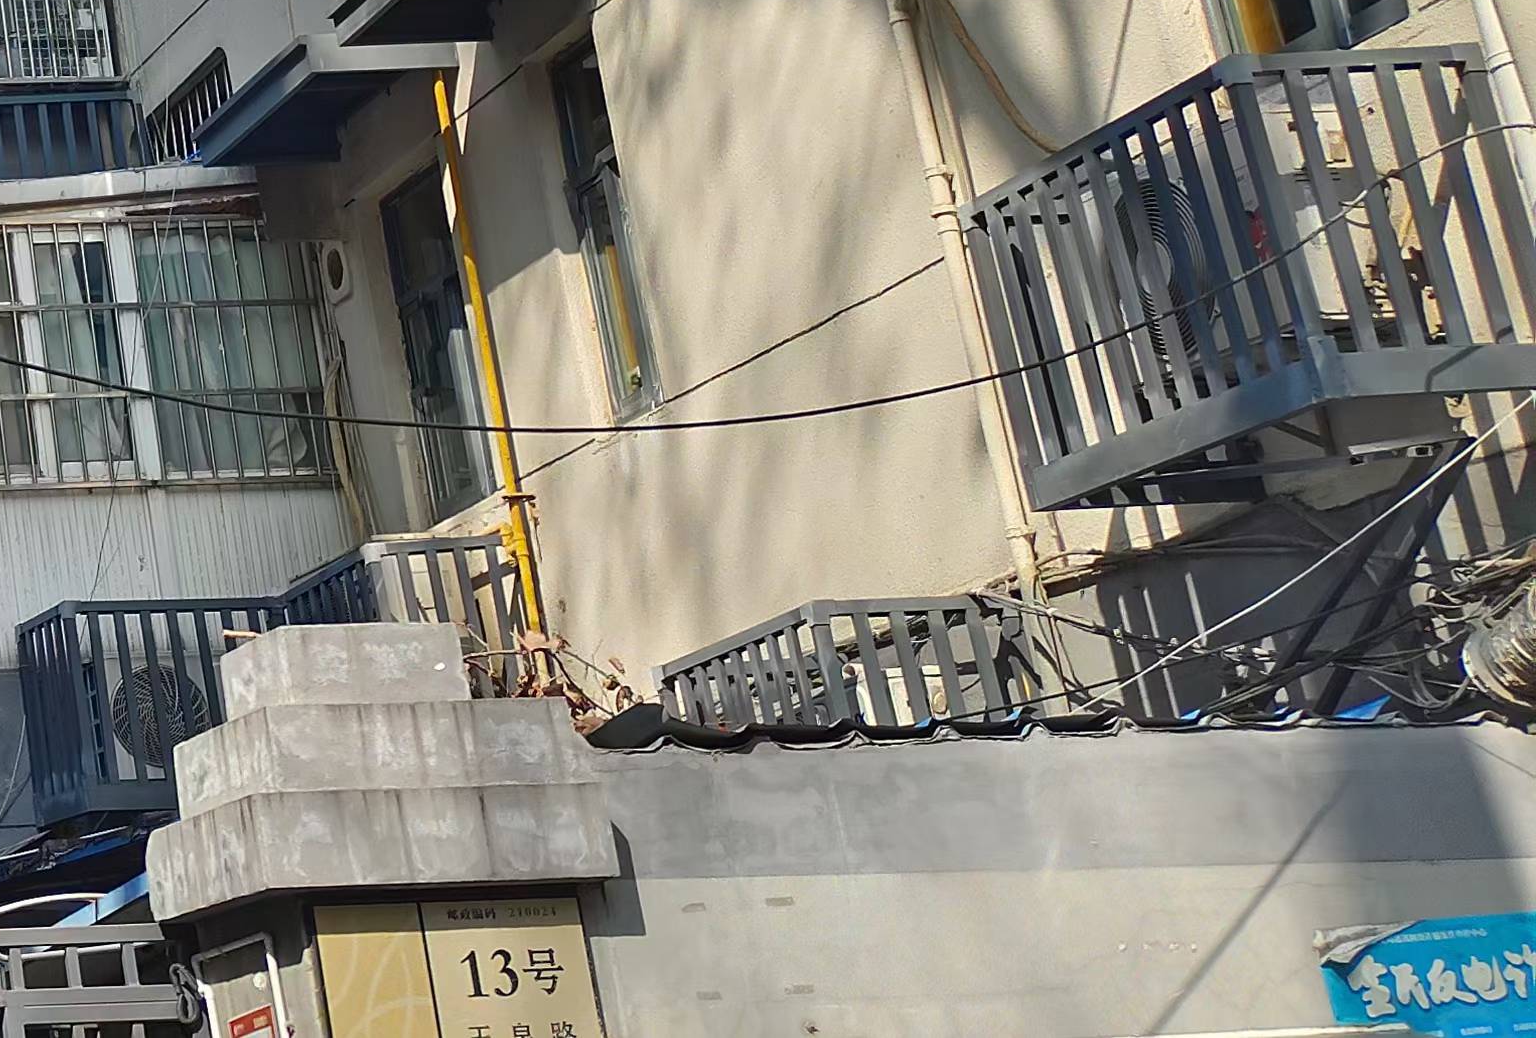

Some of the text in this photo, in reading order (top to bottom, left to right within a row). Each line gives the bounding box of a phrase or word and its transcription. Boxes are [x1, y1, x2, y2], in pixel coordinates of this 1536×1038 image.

[446, 907, 497, 920] 邮政编码
[459, 947, 566, 999] 13号
